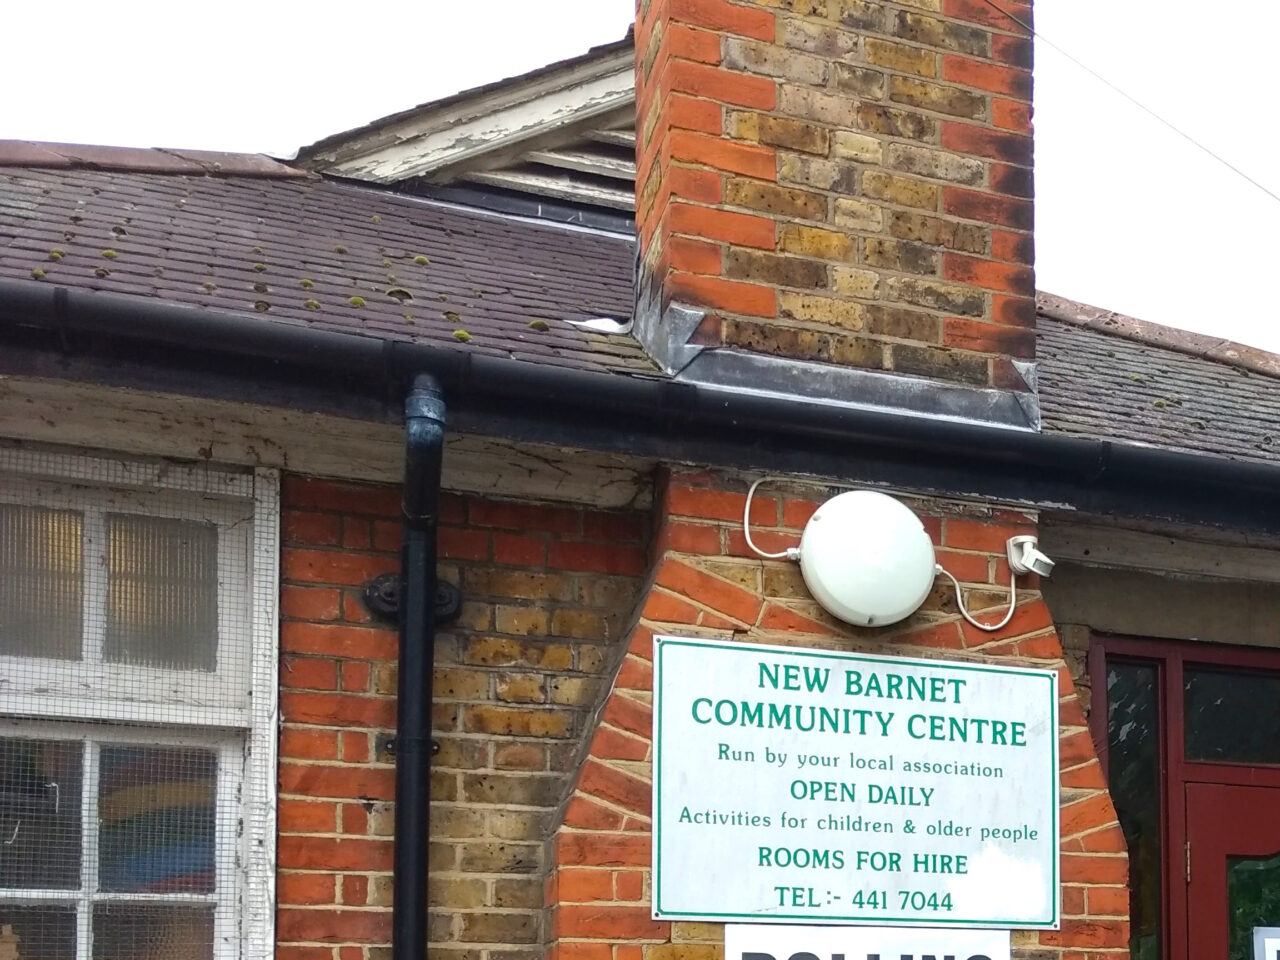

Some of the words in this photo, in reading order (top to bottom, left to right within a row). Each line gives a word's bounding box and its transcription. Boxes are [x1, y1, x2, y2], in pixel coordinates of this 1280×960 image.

[758, 663, 830, 693] NEW
[845, 670, 966, 703] BARNET
[692, 698, 894, 737] COMMUNITY
[908, 714, 1027, 746] CENTRE
[718, 743, 755, 762] Run
[765, 747, 787, 767] by
[798, 754, 840, 769] your
[850, 752, 893, 770] local
[903, 761, 1003, 778] association
[790, 780, 856, 802] OPEN
[868, 784, 934, 806] DAILY
[679, 806, 771, 827] Activities
[781, 811, 807, 828] for
[817, 814, 893, 833] children
[903, 819, 916, 834] &
[926, 820, 972, 837] older
[980, 824, 1038, 843] people
[758, 847, 844, 869] ROOMS
[856, 851, 901, 872] FOR
[913, 853, 968, 874] HIRE
[852, 890, 887, 909] 441
[899, 891, 953, 911] 7044
